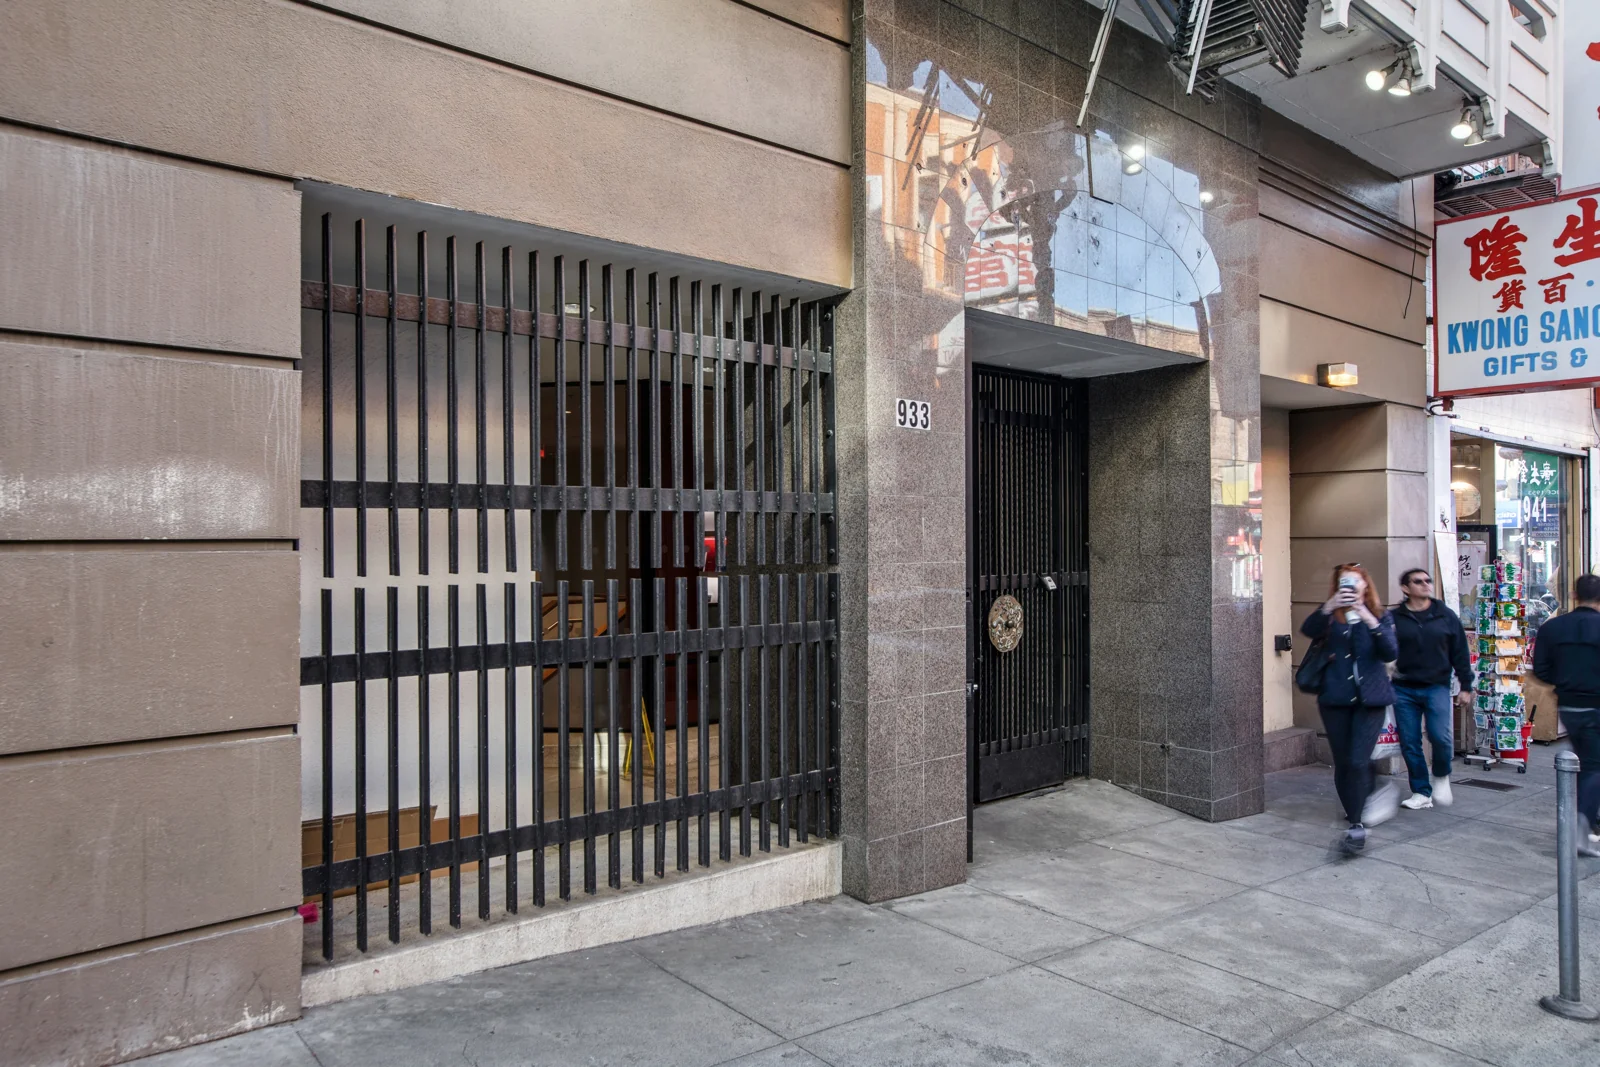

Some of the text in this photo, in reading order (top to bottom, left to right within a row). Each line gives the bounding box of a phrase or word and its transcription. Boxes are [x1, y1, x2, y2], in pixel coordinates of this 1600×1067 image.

[1447, 314, 1528, 355] KWONG
[1484, 347, 1588, 377] GIFTS &
[898, 399, 929, 429] 933
[1523, 495, 1547, 522] 941
